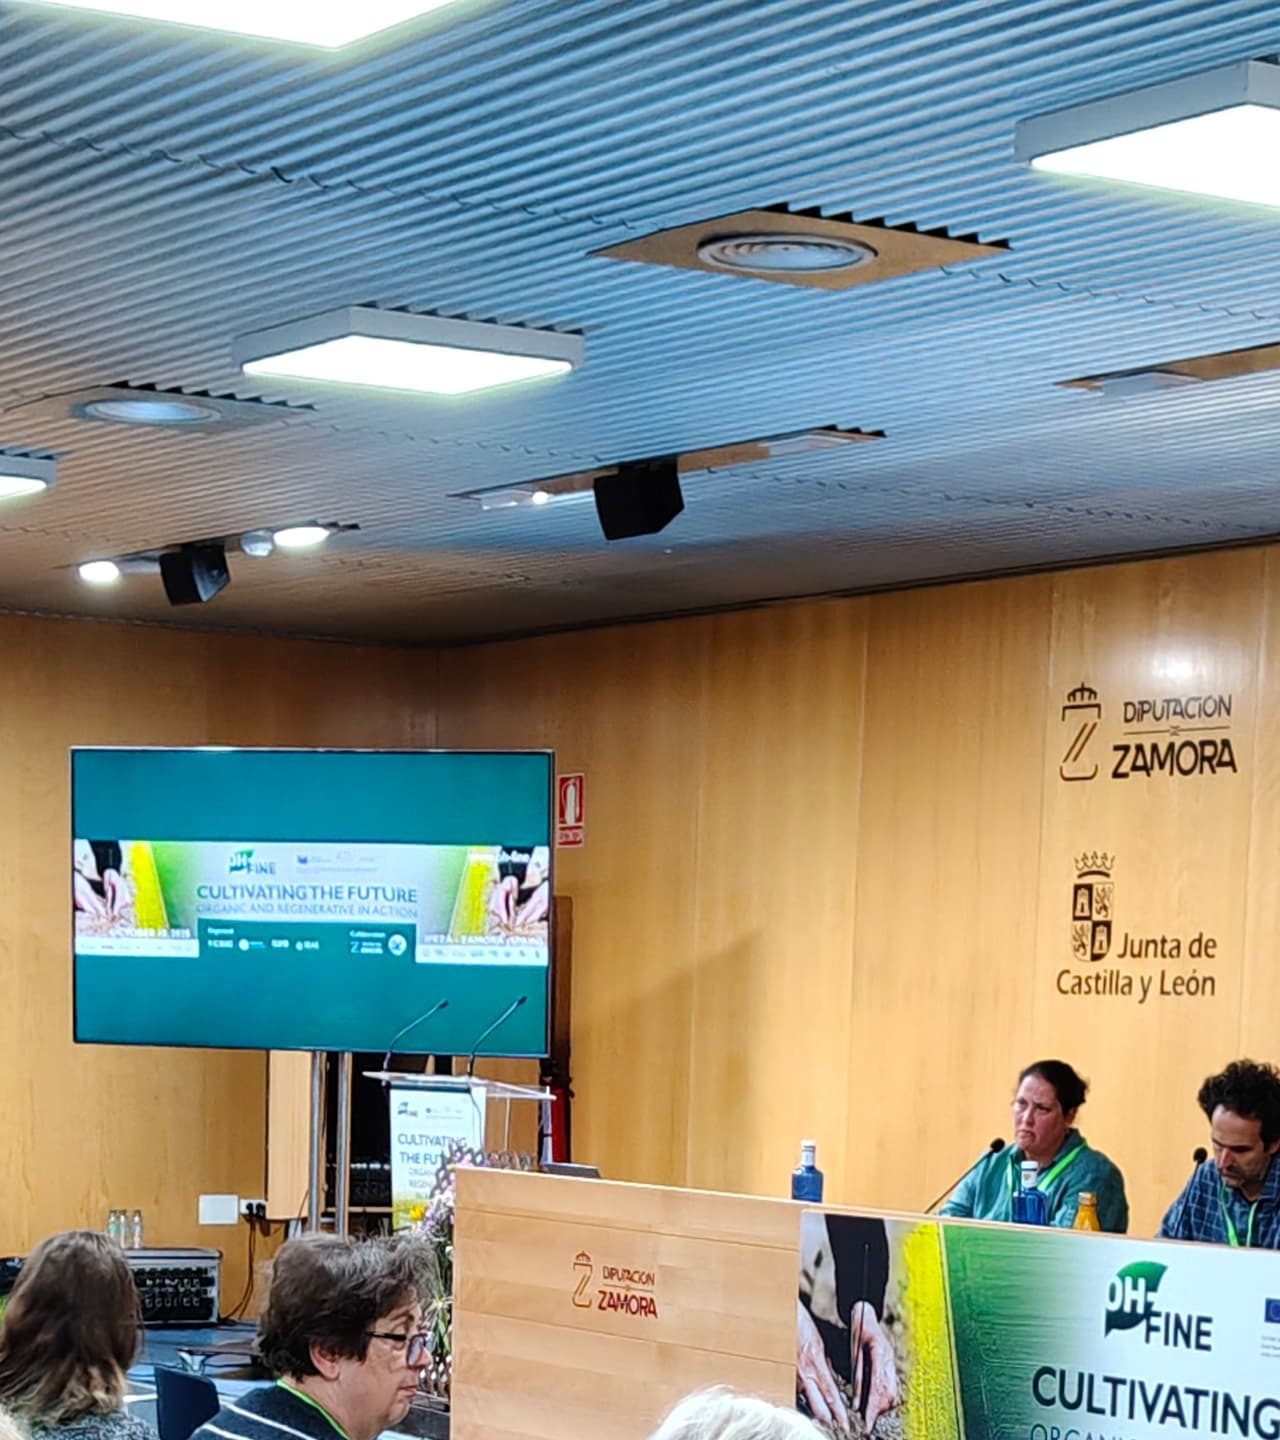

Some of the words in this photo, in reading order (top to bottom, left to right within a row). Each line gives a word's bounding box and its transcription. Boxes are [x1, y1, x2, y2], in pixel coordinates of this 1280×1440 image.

[1111, 738, 1238, 779] ZAMORA
[196, 884, 308, 901] CULTIVATING
[310, 885, 345, 901] THE
[347, 886, 418, 904] FUTURE
[196, 902, 246, 915] ORGANIC
[250, 904, 275, 915] AND
[278, 904, 354, 916] REGENERATIVE
[358, 907, 370, 917] IN
[372, 908, 418, 920] ACTION
[1117, 932, 1181, 960] Junta
[1188, 932, 1218, 959] de
[1056, 969, 1133, 997] Castilla
[1137, 975, 1153, 1005] y
[1159, 968, 1216, 997] León
[399, 1152, 422, 1165] THE
[598, 1289, 658, 1320] ZAMORA
[1144, 1310, 1214, 1352] FINE
